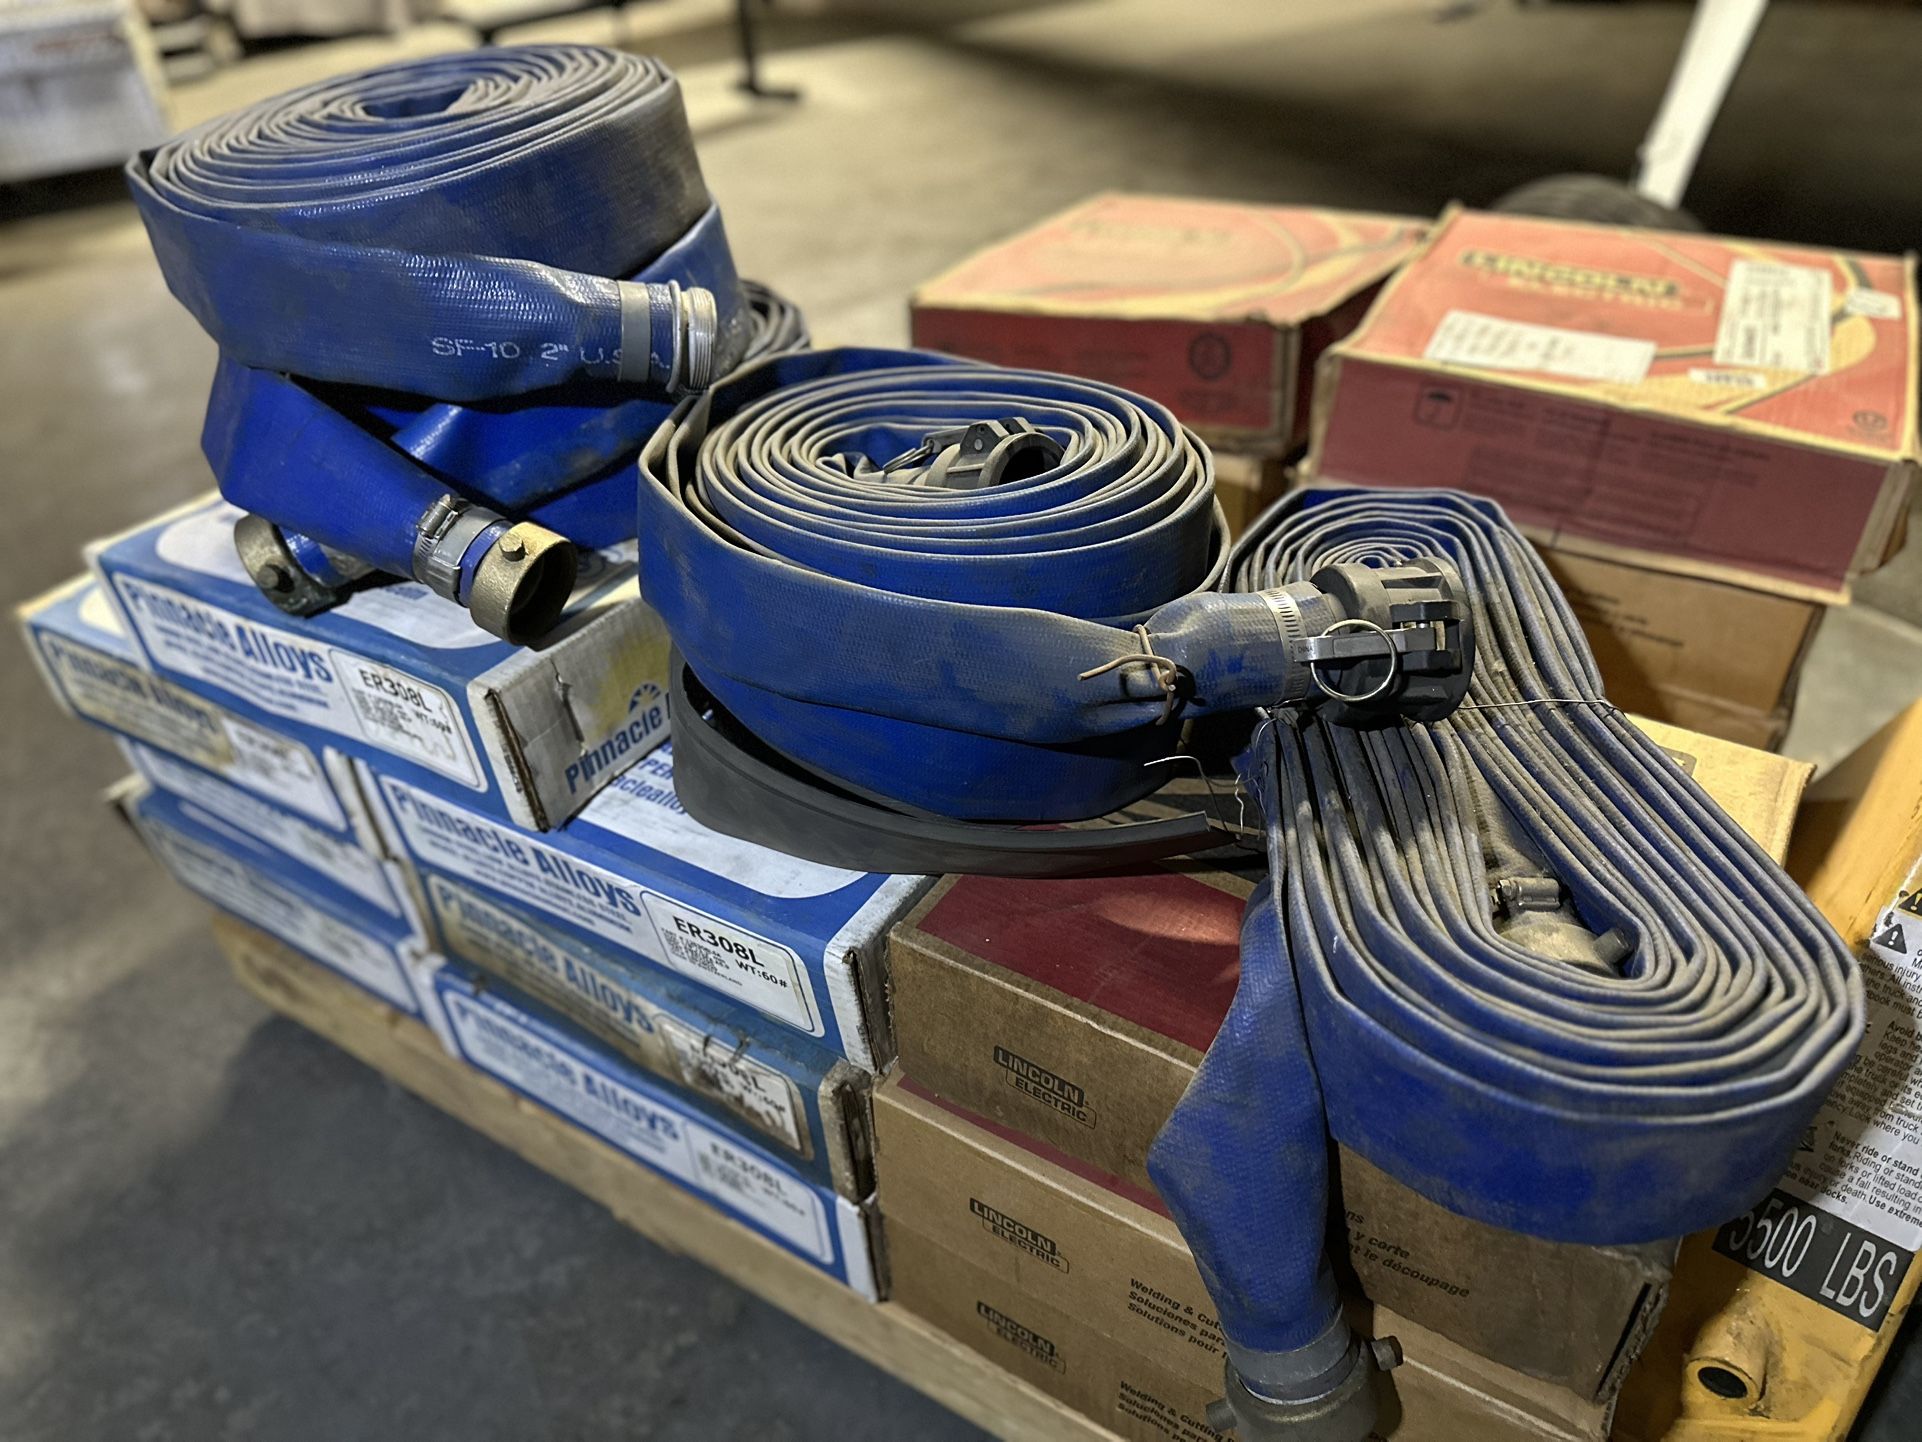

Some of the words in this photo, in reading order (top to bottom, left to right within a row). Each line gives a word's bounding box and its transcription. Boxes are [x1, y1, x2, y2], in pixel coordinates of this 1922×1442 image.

[235, 624, 333, 683] Alloys
[358, 668, 432, 713] ER308L
[565, 706, 663, 795] Pinnacle
[390, 784, 530, 866] Pinnacle
[531, 846, 642, 916] Alloys
[672, 915, 765, 968] ER308L
[735, 958, 788, 988] WT:60#
[1895, 965, 1922, 983] injury
[563, 957, 655, 1034] Alloys
[1888, 1021, 1915, 1038] Avoid
[997, 1048, 1080, 1105] LINCOLN
[1014, 1075, 1088, 1122] ELECTRIC
[1873, 1119, 1901, 1136] where
[1902, 1132, 1920, 1145] you
[1896, 1116, 1919, 1133] truck
[1839, 1157, 1860, 1174] forks
[1861, 1169, 1872, 1179] or
[1873, 1173, 1897, 1191] lifted
[1853, 1151, 1882, 1172] Riding
[1883, 1167, 1895, 1177] or
[1862, 1144, 1879, 1158] ride
[1881, 1153, 1892, 1164] or
[1892, 1160, 1920, 1176] stand
[1856, 1176, 1871, 1191] fall
[1871, 1185, 1911, 1211] resulting
[1868, 1195, 1886, 1210] Use
[973, 1200, 1051, 1253] LINCOLN
[991, 1224, 1061, 1269] ELECTRIC
[1368, 1235, 1411, 1259] corte
[1130, 1277, 1181, 1311] Welding
[1183, 1305, 1194, 1316] &
[1382, 1256, 1470, 1298] découpage
[1819, 1232, 1898, 1319] LBS
[979, 1303, 1051, 1356] LINCOLN
[1127, 1302, 1186, 1337] Solutions
[1188, 1335, 1220, 1355] pour
[1128, 1290, 1198, 1332] Soluciones
[1117, 1402, 1169, 1436] Solutions
[1118, 1392, 1180, 1430] Soluciones
[1120, 1380, 1166, 1412] Welding
[1167, 1407, 1177, 1417] &
[1179, 1414, 1224, 1442] Cutting
